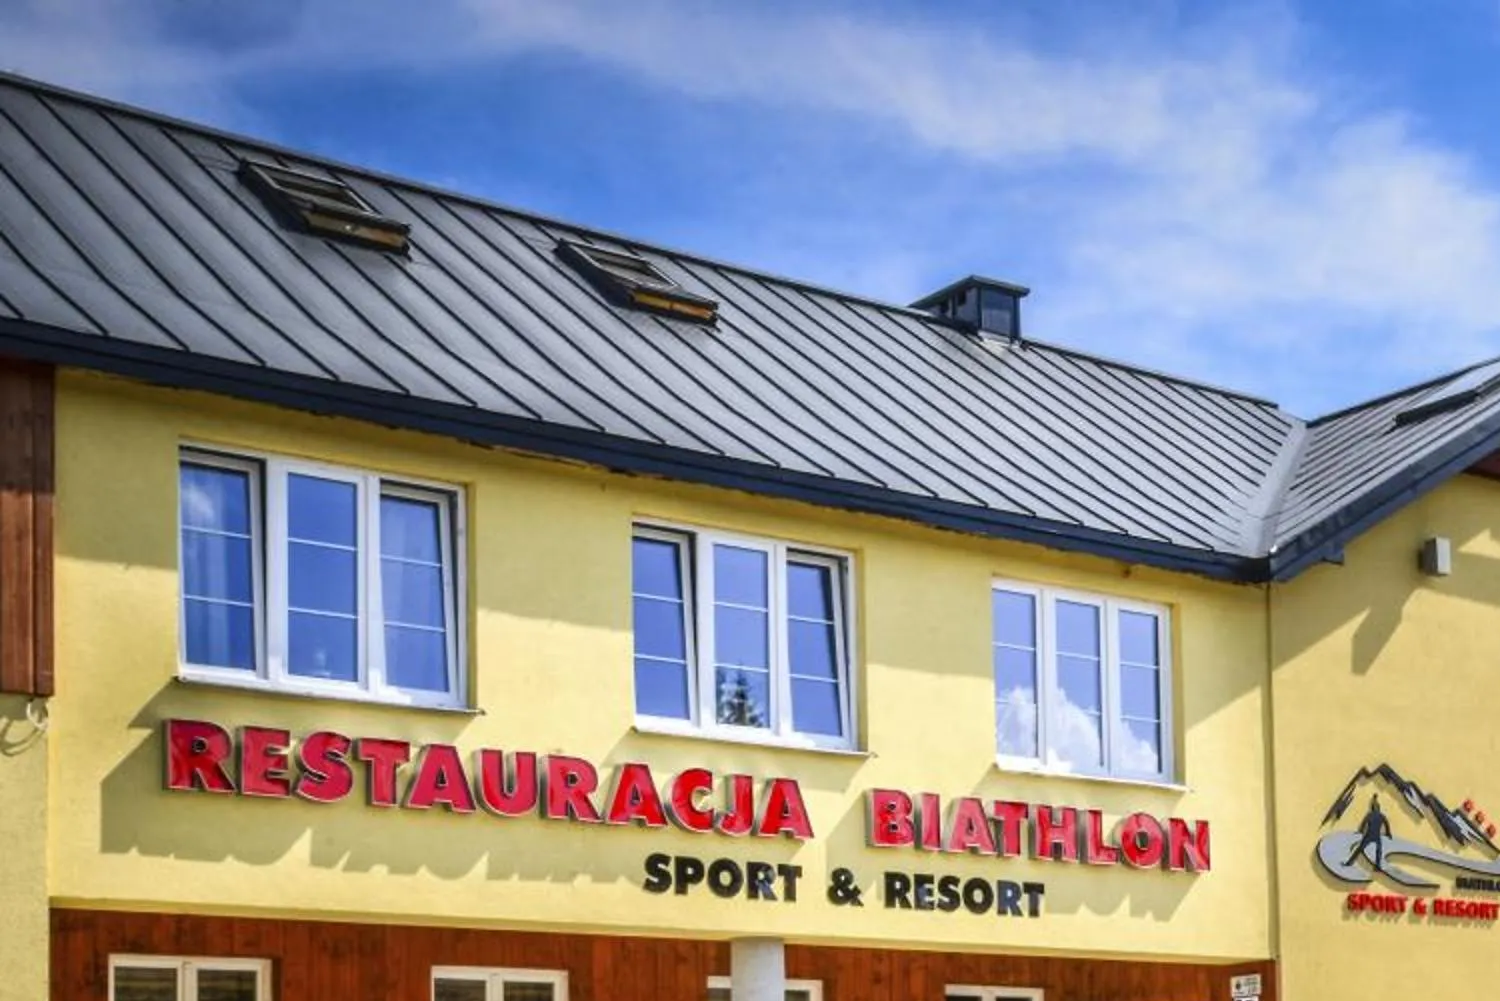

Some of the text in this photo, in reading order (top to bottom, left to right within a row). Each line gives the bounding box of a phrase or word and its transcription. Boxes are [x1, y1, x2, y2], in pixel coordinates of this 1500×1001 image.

[164, 718, 1210, 872] RESTAURACJA BIATHLON
[643, 852, 1045, 917] SPORT & RESORT
[1346, 892, 1408, 913] SPORT
[1412, 897, 1427, 916] &
